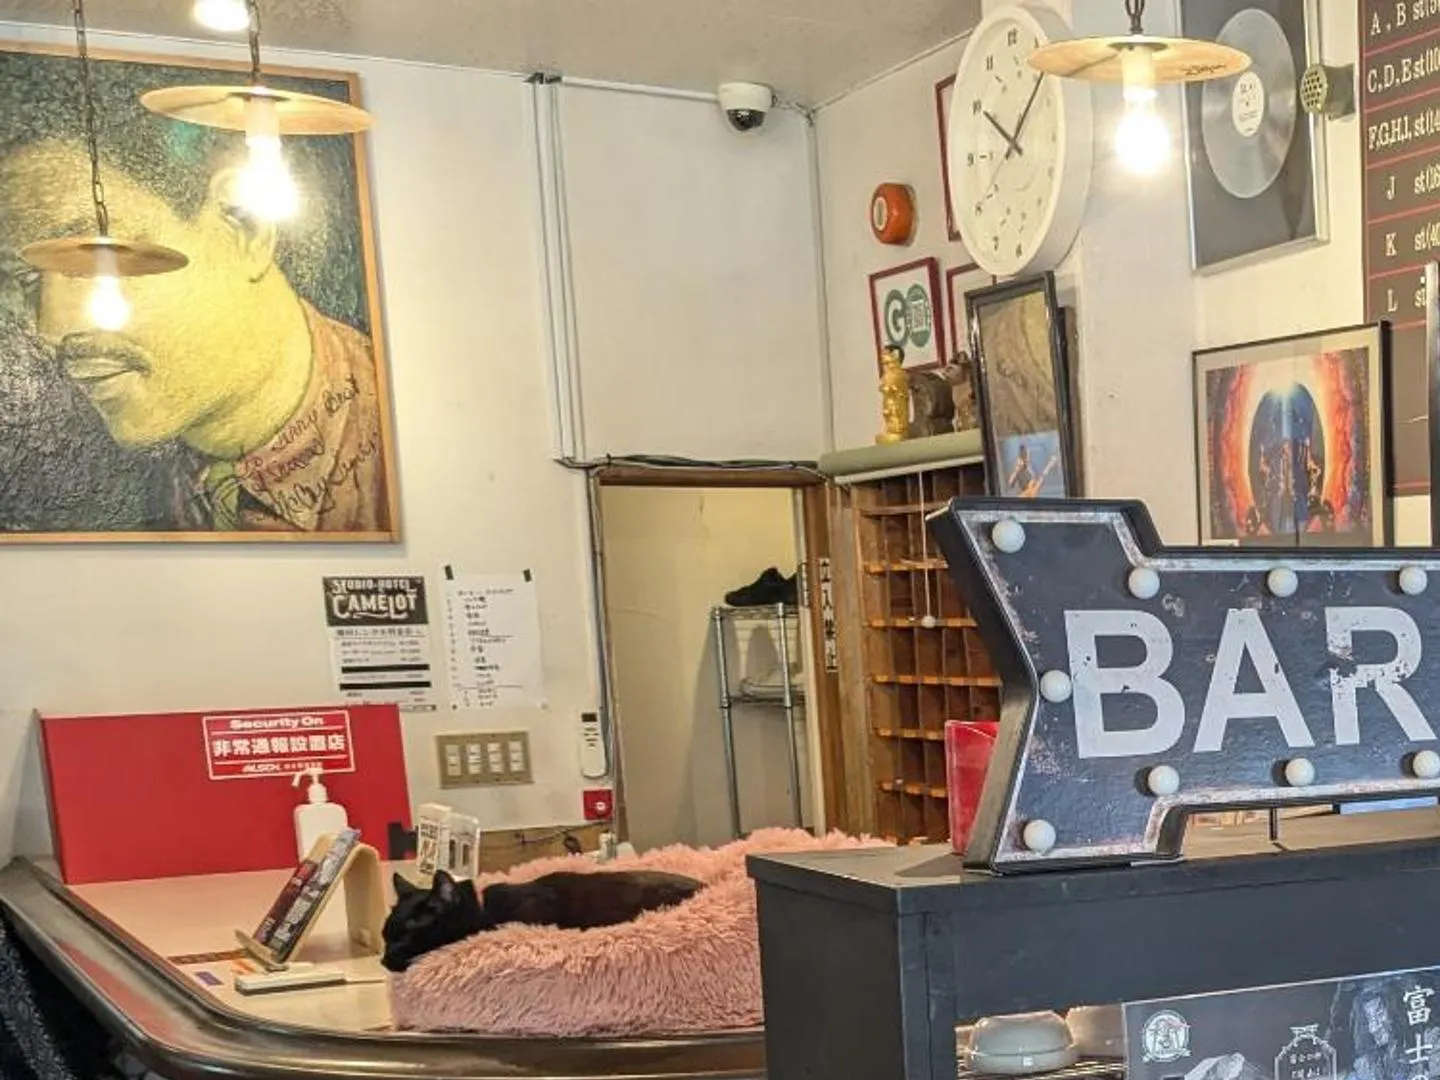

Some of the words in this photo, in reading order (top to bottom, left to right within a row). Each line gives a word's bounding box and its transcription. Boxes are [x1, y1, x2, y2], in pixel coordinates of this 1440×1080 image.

[332, 594, 418, 620] CAMELOT
[1064, 605, 1437, 759] BAR
[230, 716, 300, 731] Security
